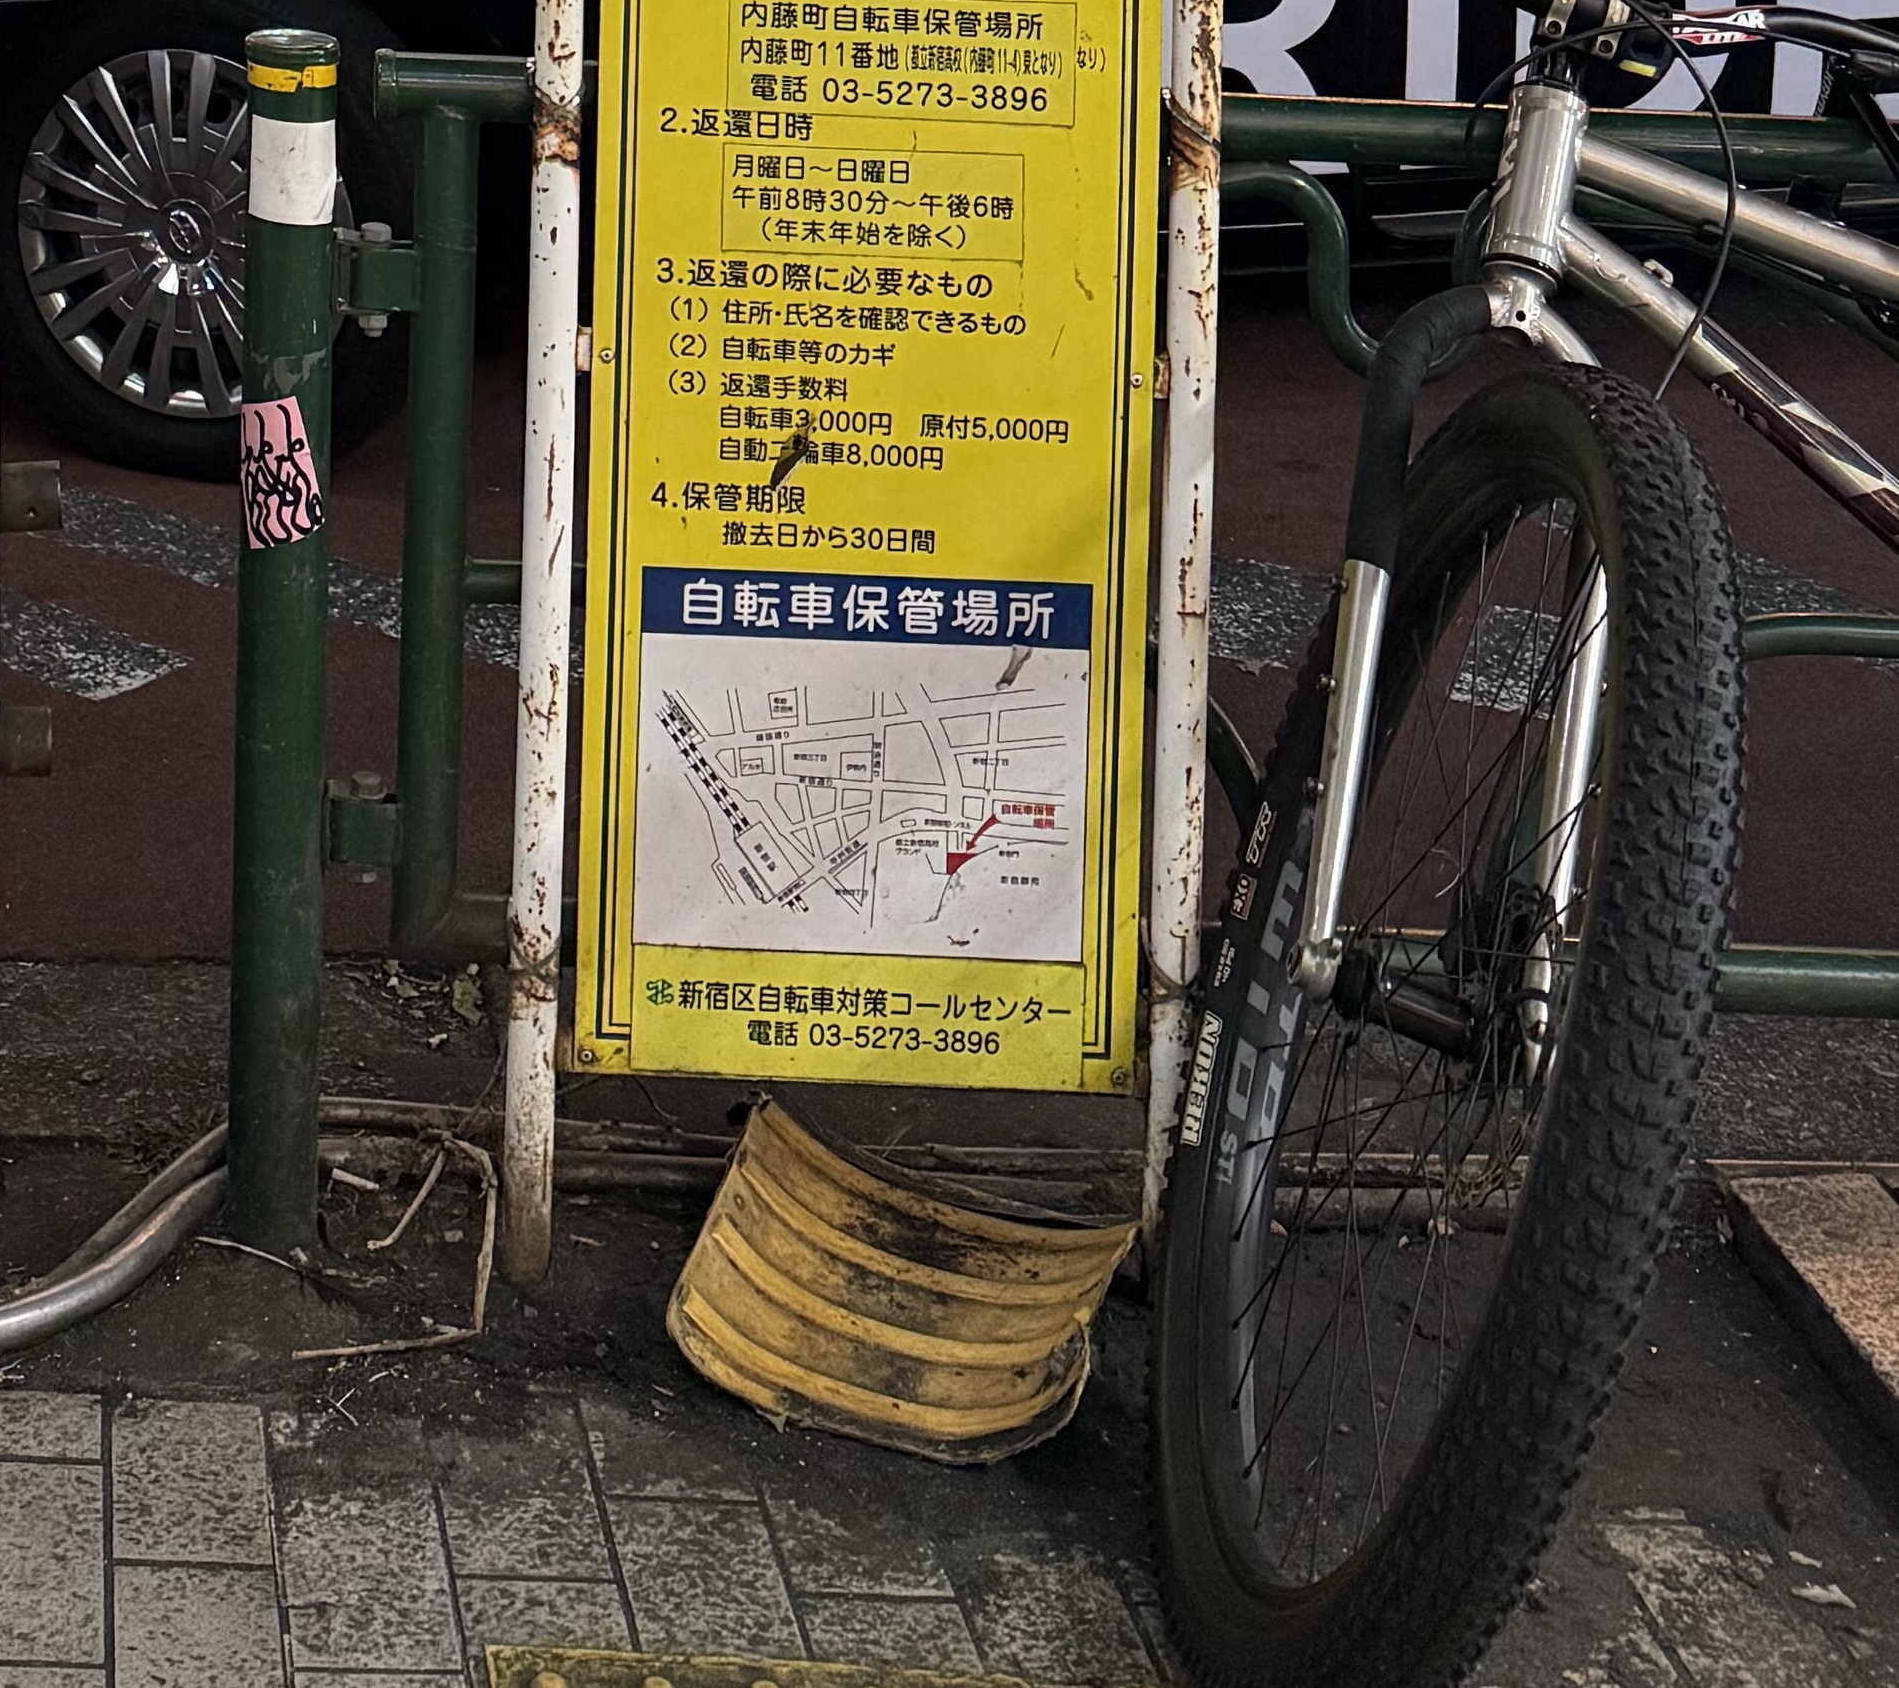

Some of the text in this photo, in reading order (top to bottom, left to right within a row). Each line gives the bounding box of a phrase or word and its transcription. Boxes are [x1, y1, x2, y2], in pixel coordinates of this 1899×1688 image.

[740, 1, 1045, 41] 内藤町自転車保管場所
[740, 36, 901, 71] 内藤町11番地
[751, 74, 1048, 113] 電話 03-5273-3896
[660, 108, 814, 141] 2.返還日時
[761, 218, 967, 250] （年末年始を除く）
[656, 257, 993, 300] 3.返還の際に必要なもの
[722, 298, 1027, 336] 住所・氏名を確認できるもの
[721, 337, 897, 367] 自転車等のカギ
[720, 374, 849, 402] 返還手数料
[720, 406, 1069, 444] 自転車3,000円 原付5,000円
[650, 482, 807, 515] 4.保管期限
[722, 521, 936, 554] 撤去日から30日間
[682, 577, 1056, 639] 自転車保管場所
[677, 980, 1072, 1022] 新宿区自転車対策コールセンター
[746, 1020, 1000, 1055] 電話 03-5273-3896
[1181, 1010, 1224, 1146] REKON
